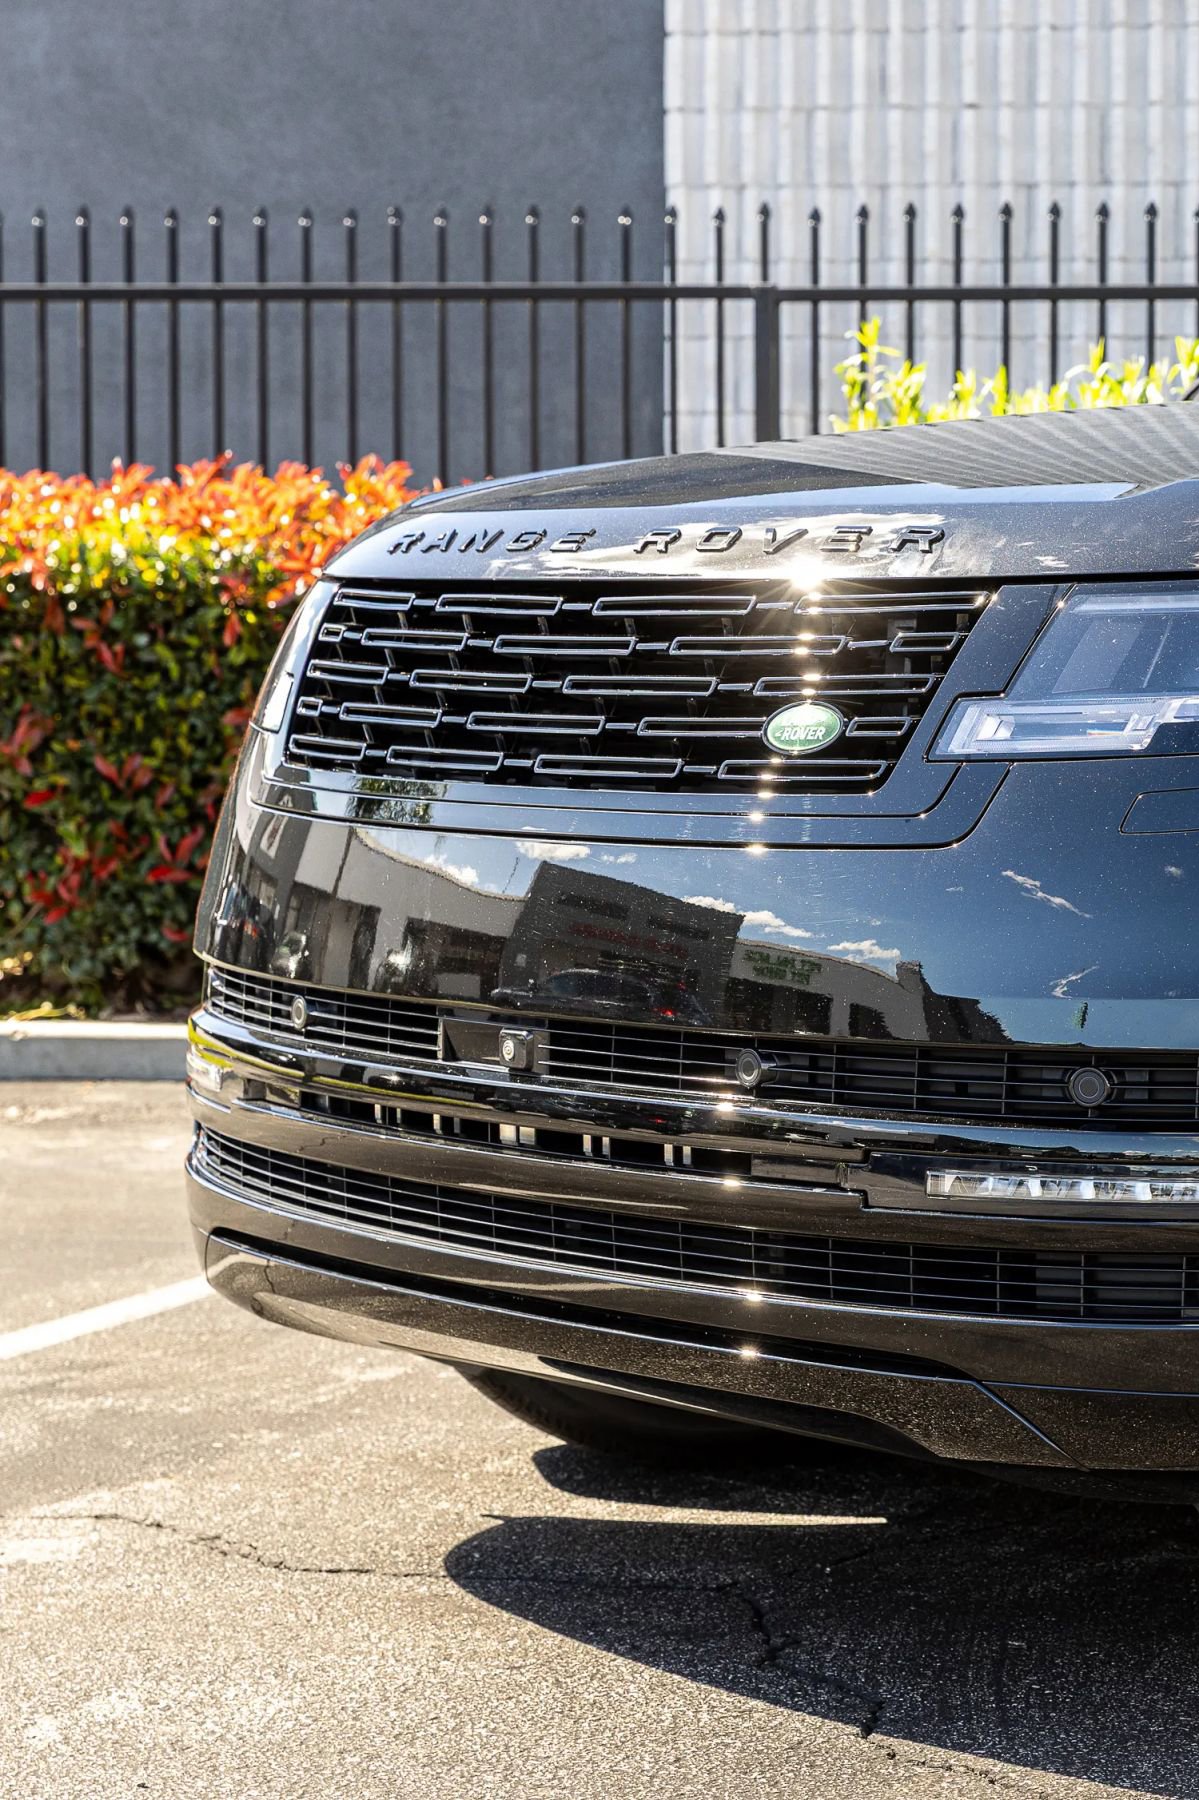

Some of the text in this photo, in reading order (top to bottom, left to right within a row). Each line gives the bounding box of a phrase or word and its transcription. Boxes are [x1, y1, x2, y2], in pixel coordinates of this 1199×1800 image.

[387, 525, 945, 555] RANGE ROVER
[781, 726, 826, 741] ROVER
